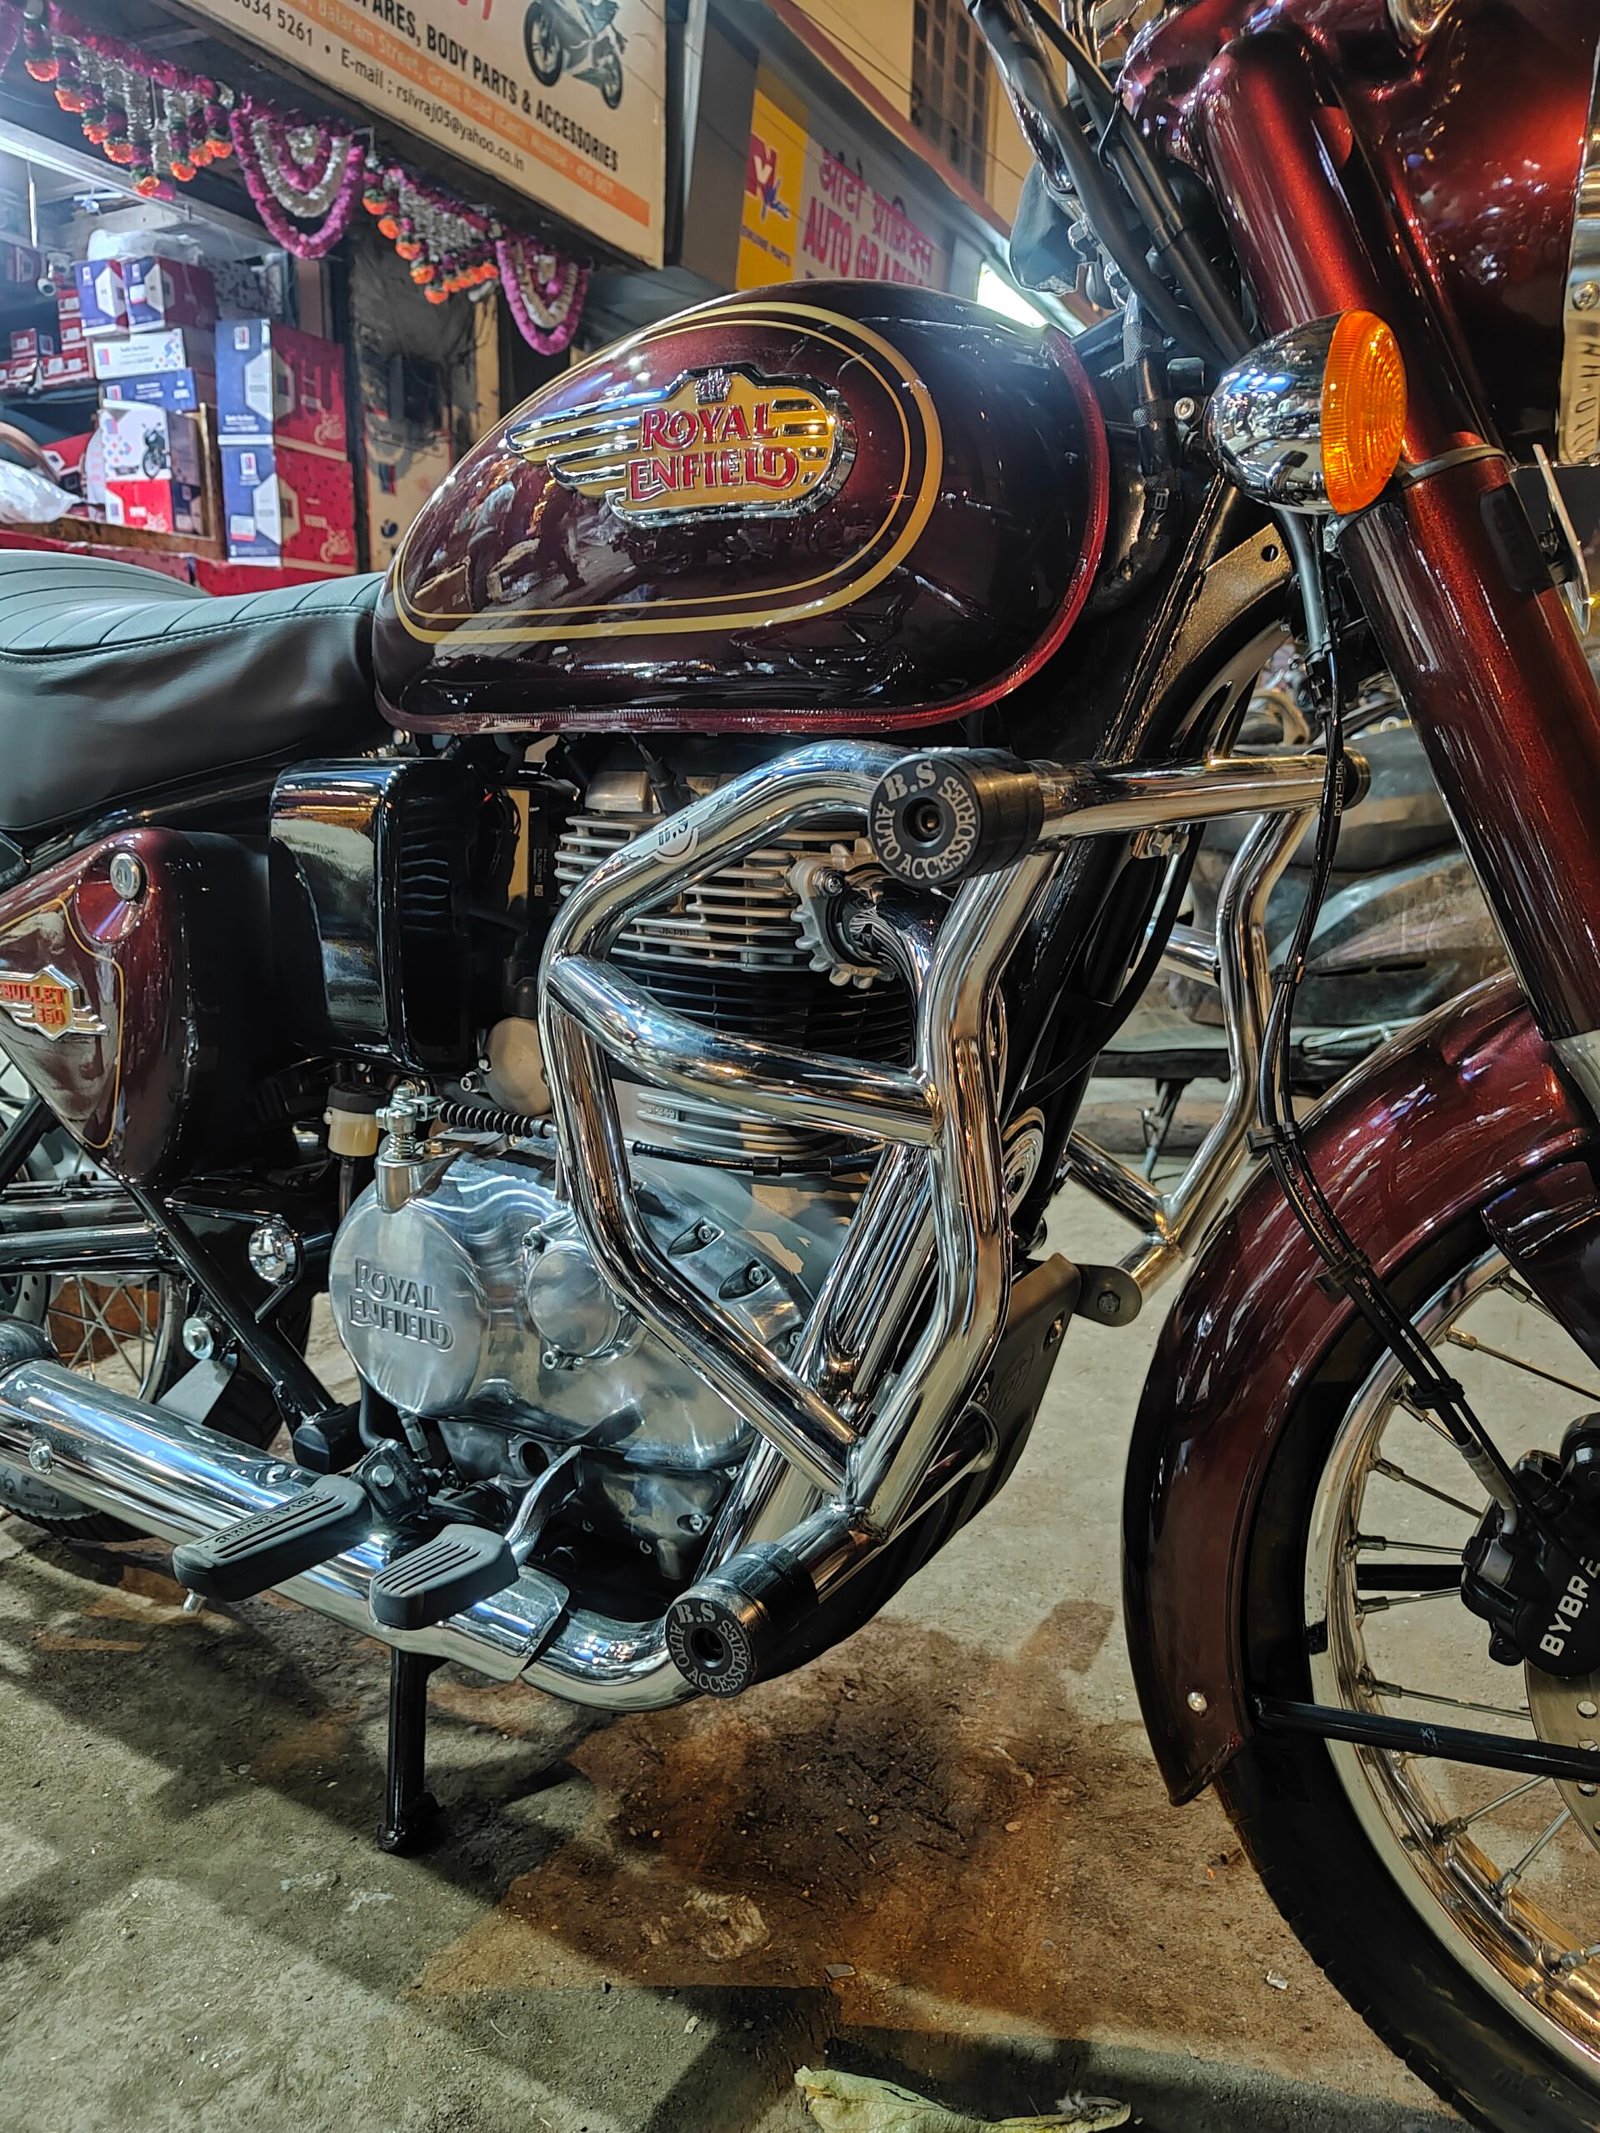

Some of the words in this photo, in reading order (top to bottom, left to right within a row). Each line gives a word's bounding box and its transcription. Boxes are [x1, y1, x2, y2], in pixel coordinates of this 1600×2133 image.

[233, 0, 271, 21] 34
[277, 7, 313, 47] 5261
[340, 47, 384, 89] E-mail
[354, 0, 421, 47] ARES,
[426, 24, 468, 72] BODY
[472, 55, 517, 105] PARTS
[521, 89, 531, 116] &
[535, 103, 619, 172] ACCESSORIES
[802, 195, 853, 278] AUTO
[640, 401, 779, 452] ROYAL
[626, 446, 800, 502] ENFIELD
[882, 760, 937, 802] B.S
[874, 801, 901, 861] AUTO
[895, 776, 976, 880] ACCESSORIES
[2, 982, 66, 1005] BULLET
[37, 1007, 67, 1025] 350
[354, 1256, 441, 1315] ROYAL
[347, 1292, 455, 1353] ENFIELD
[674, 1602, 717, 1624] B.S
[669, 1620, 691, 1668] AUTO
[686, 1619, 749, 1692] ACCESSORIES
